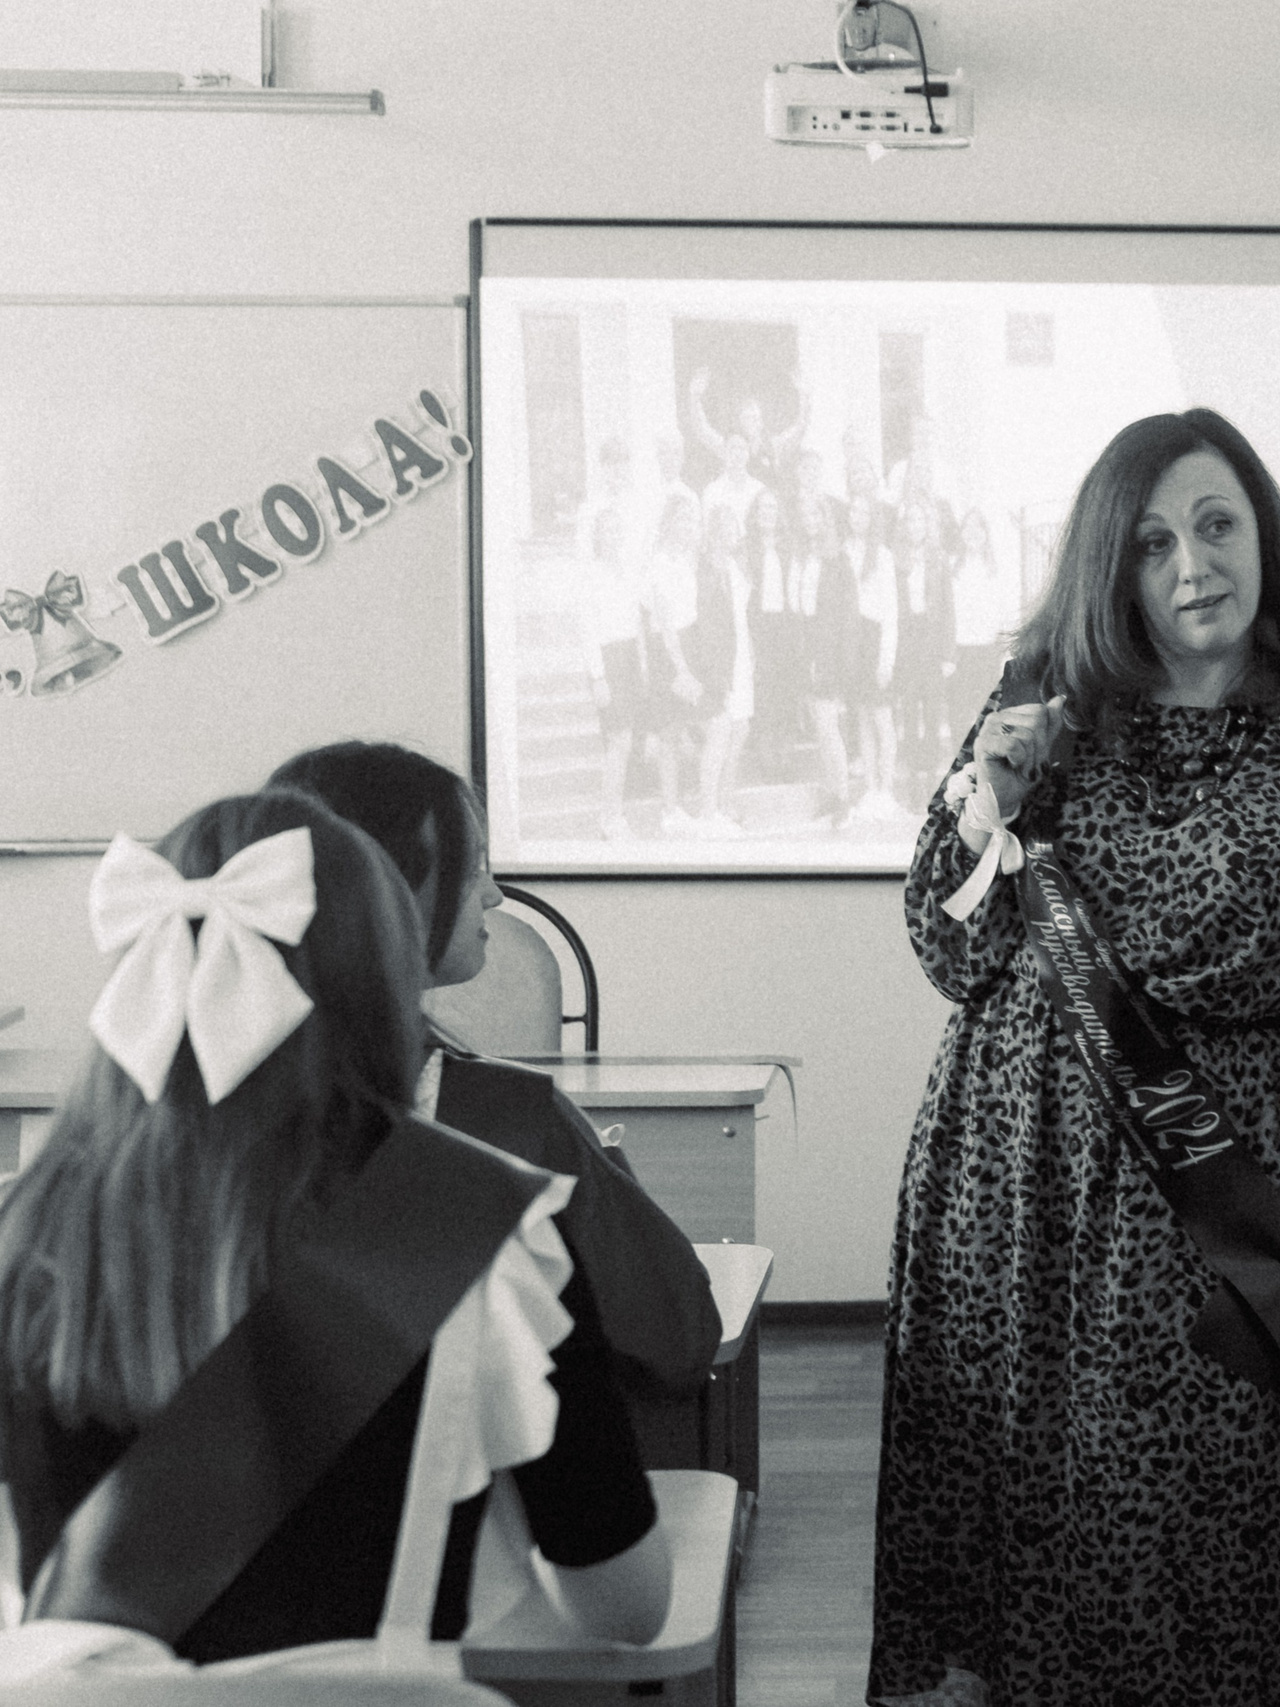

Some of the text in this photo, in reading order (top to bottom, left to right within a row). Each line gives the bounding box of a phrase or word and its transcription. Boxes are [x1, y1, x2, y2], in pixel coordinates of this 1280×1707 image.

[116, 388, 470, 640] ШКОЛА!
[1027, 842, 1104, 971] Классный
[1031, 920, 1136, 1087] руководитель
[1127, 1070, 1234, 1170] 2024
